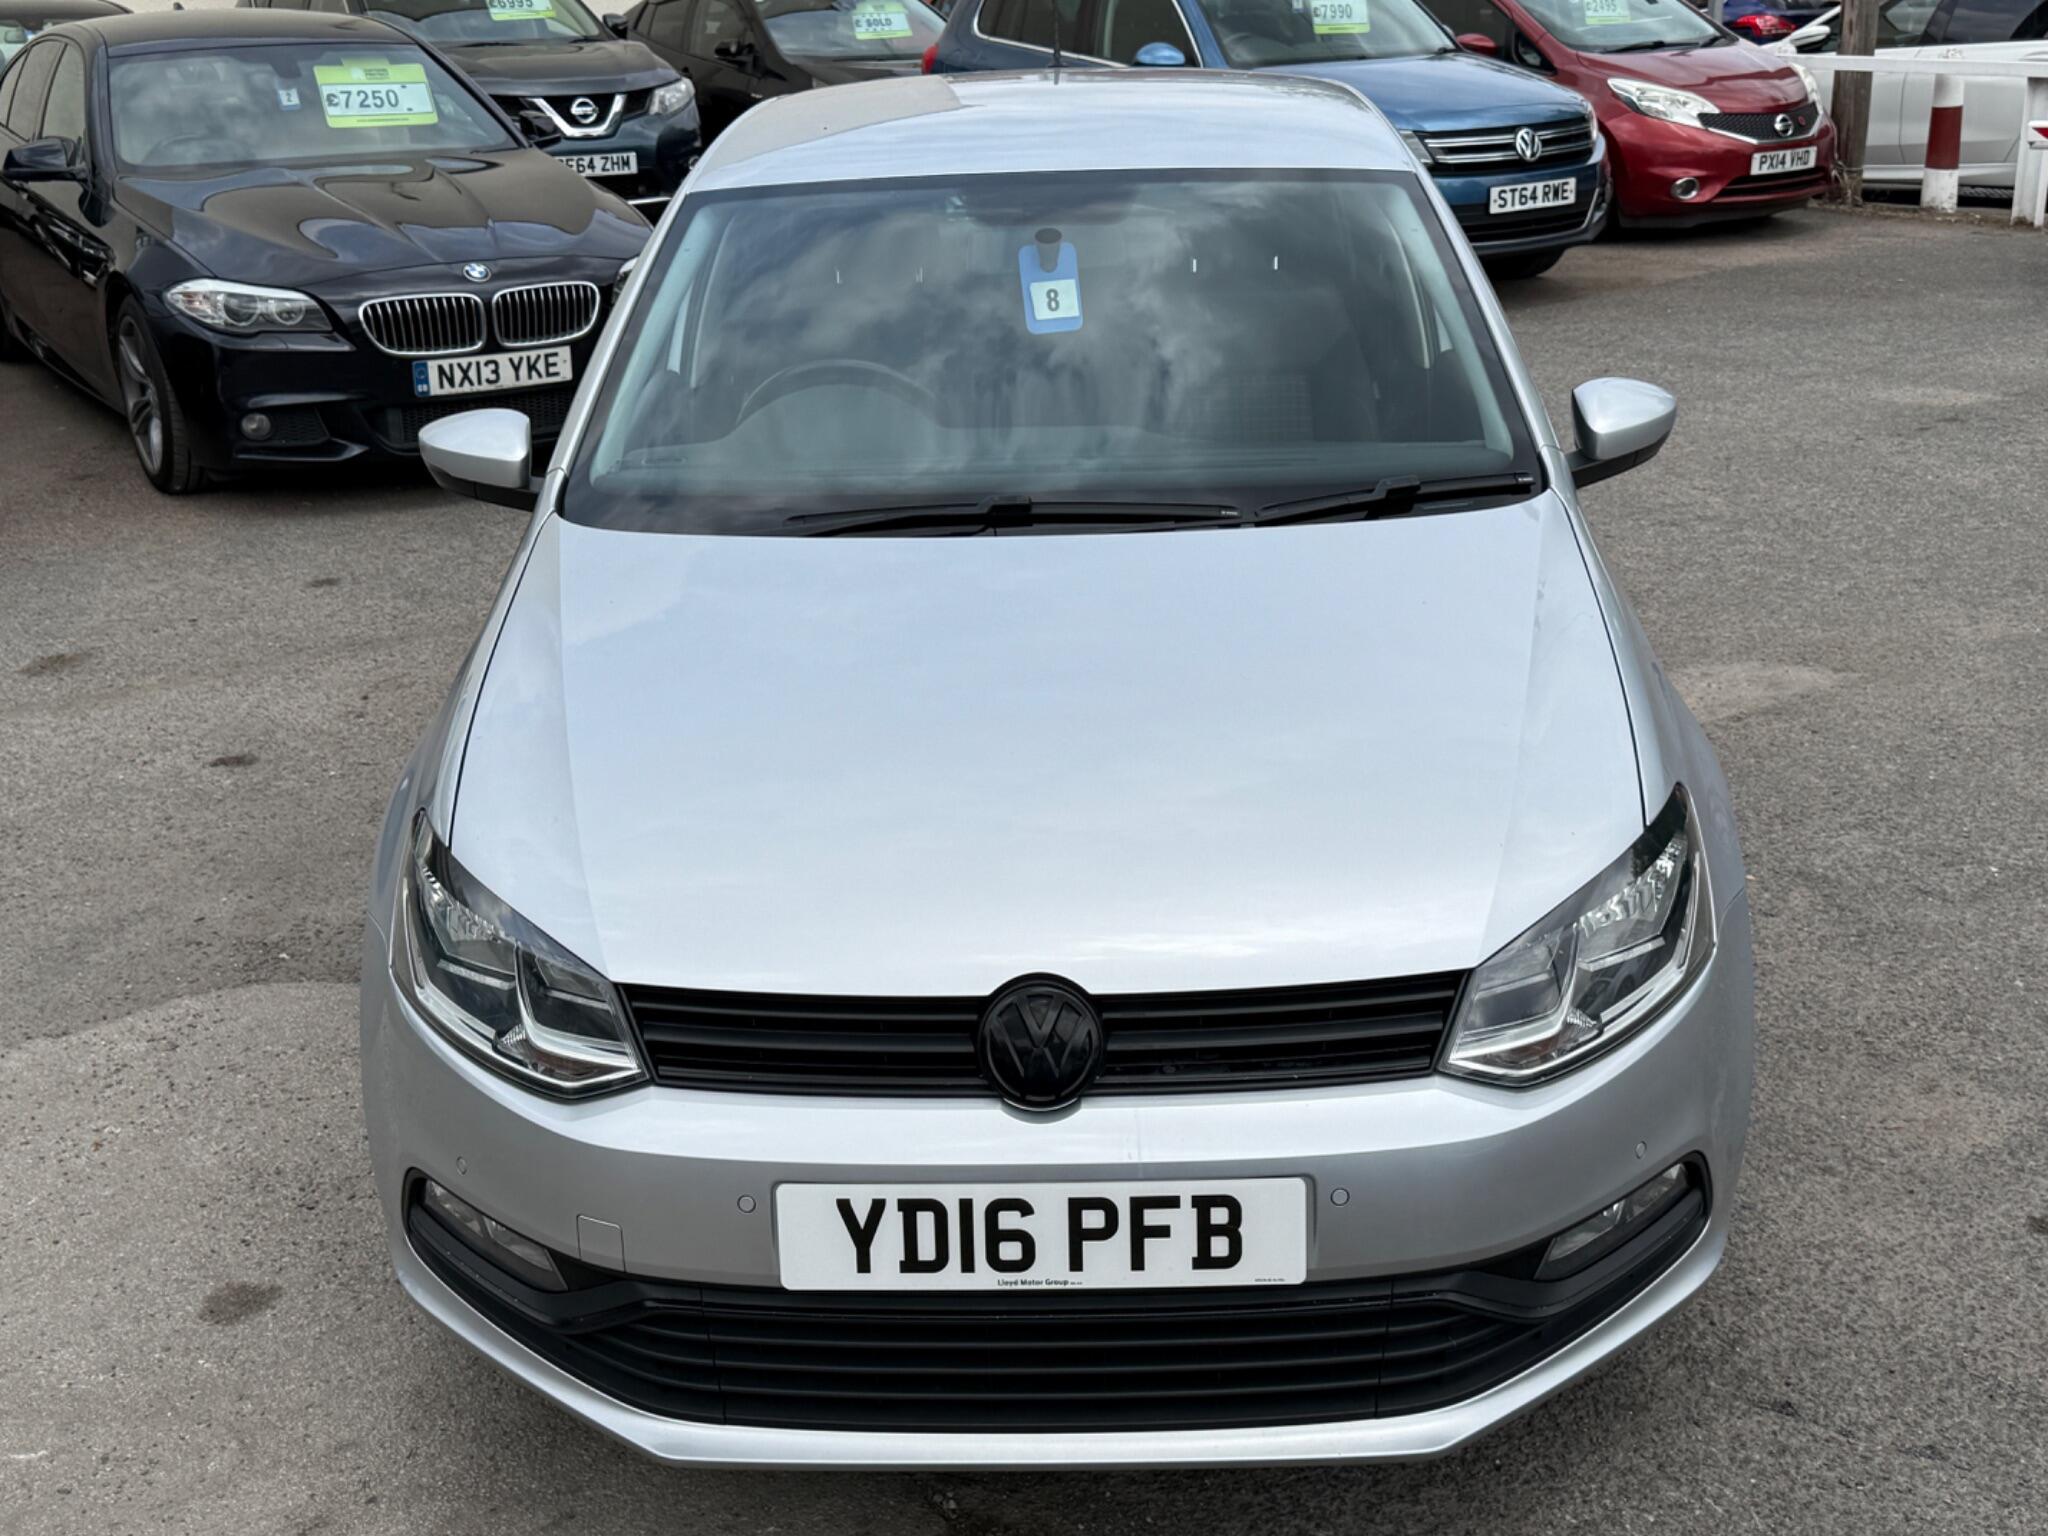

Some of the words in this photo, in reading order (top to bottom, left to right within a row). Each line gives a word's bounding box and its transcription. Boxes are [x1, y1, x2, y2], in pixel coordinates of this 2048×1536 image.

[326, 89, 400, 109] £7250
[600, 155, 632, 172] ZHM
[1758, 153, 1787, 171] PX14
[1498, 185, 1538, 209] ST64
[1542, 181, 1570, 203] RWE
[1046, 288, 1060, 312] 8
[437, 360, 500, 390] NX13
[508, 352, 561, 382] YKE
[835, 1198, 1036, 1274] YD16
[1068, 1194, 1243, 1272] PFB
[1045, 1278, 1069, 1286] Group
